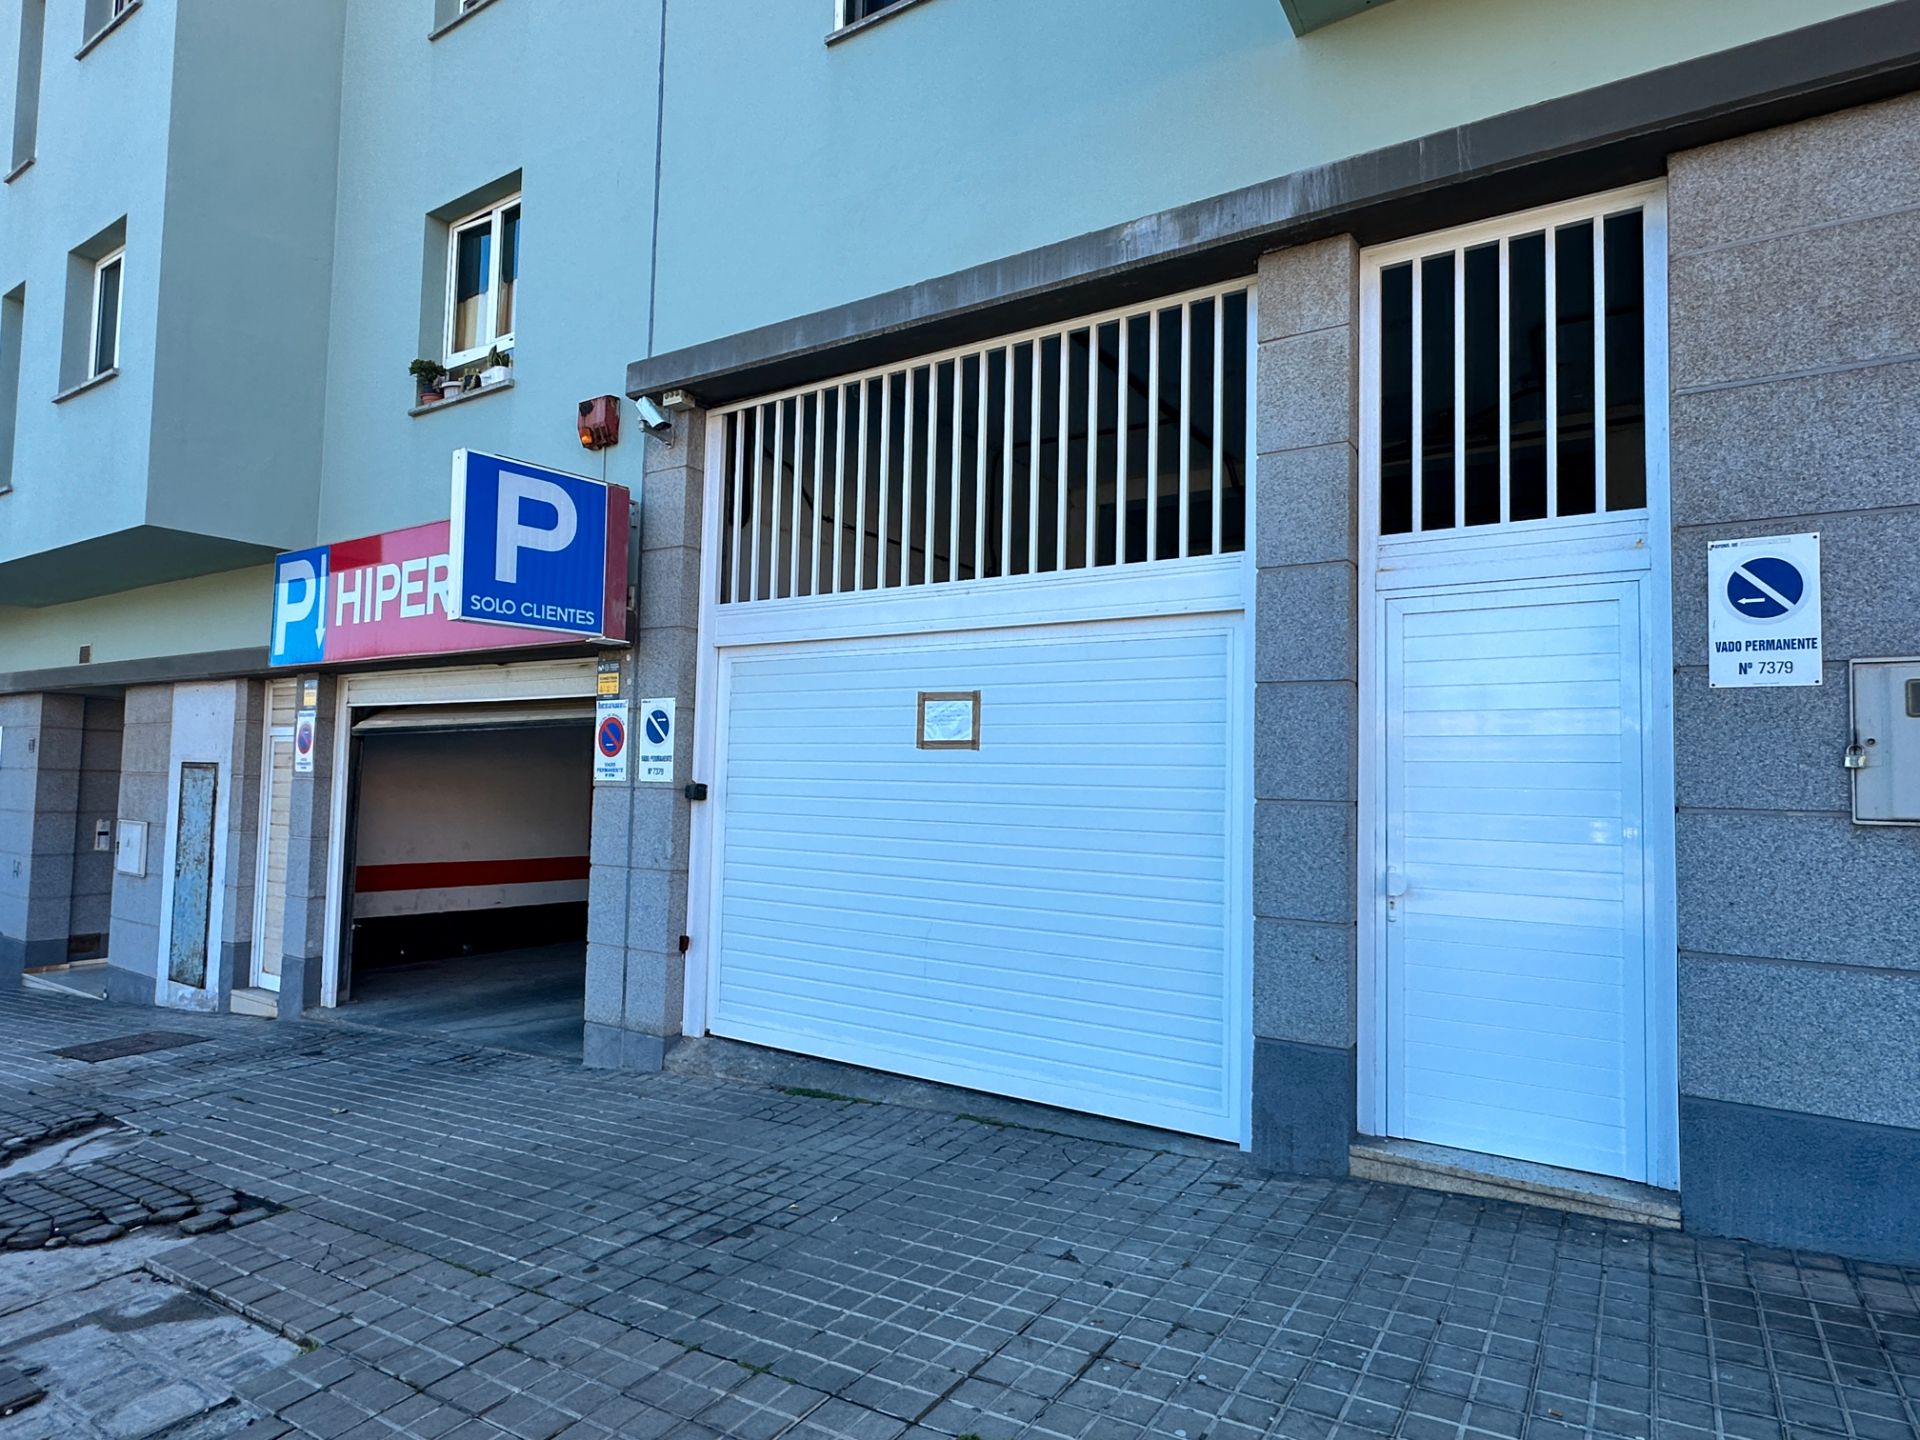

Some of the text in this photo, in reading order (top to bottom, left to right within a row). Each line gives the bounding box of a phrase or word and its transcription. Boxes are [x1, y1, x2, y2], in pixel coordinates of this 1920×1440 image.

[495, 469, 578, 584] P
[274, 559, 316, 656] P
[335, 553, 450, 627] HIPER
[470, 595, 595, 625] SOLO CLIENTES
[1715, 637, 1818, 653] VADO PERMANENTE
[1758, 661, 1794, 674] 7379
